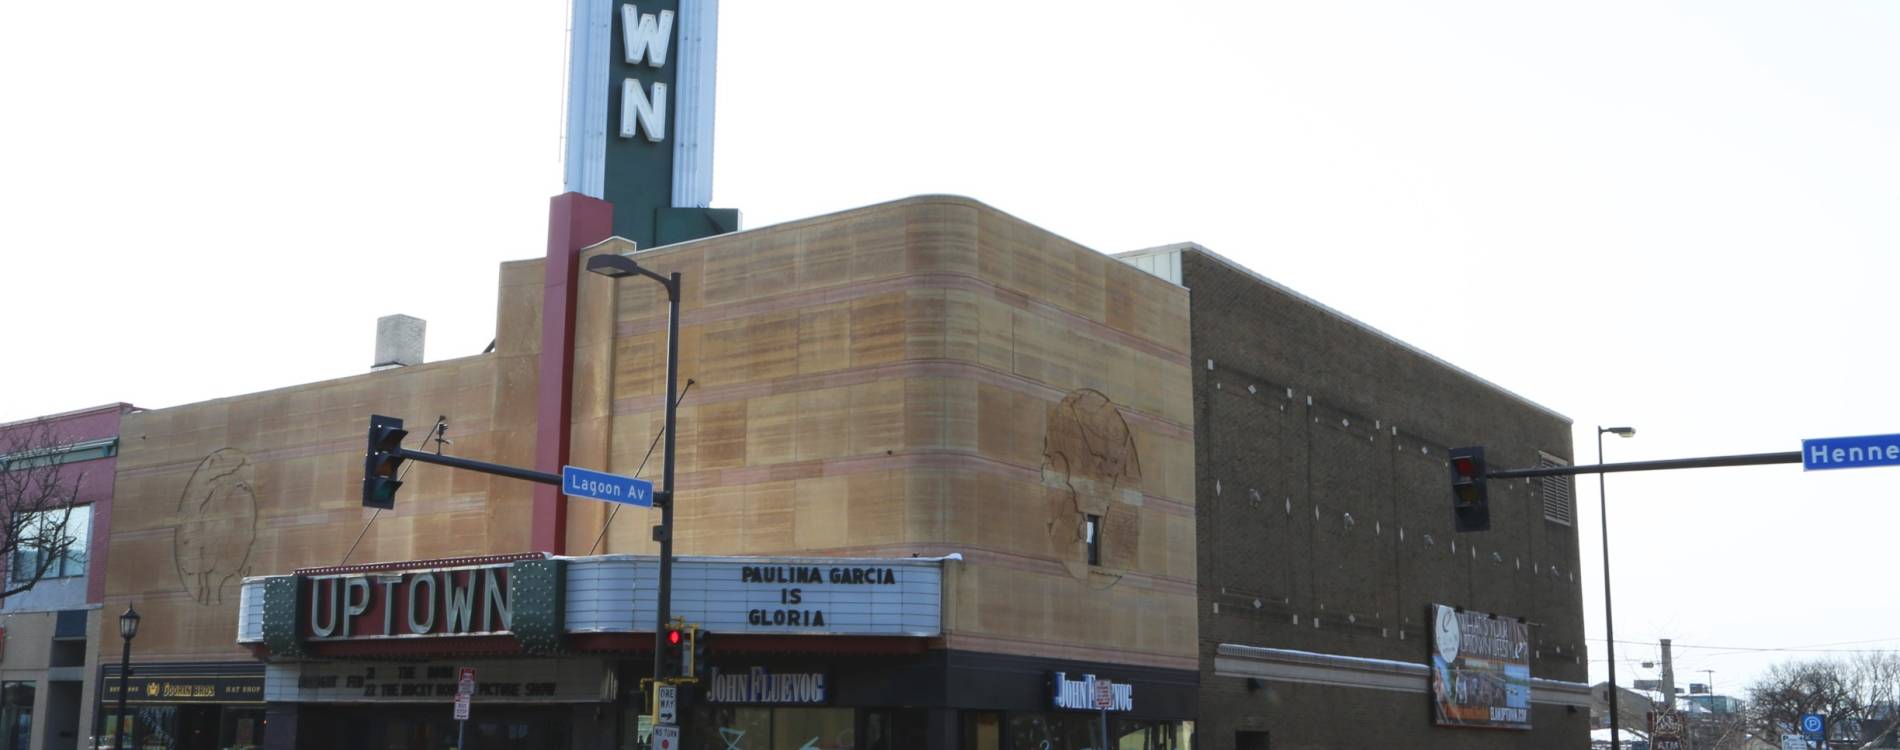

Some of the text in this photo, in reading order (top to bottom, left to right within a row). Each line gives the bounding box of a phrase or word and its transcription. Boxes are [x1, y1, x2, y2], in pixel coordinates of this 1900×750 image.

[572, 474, 645, 500] Lagoon Av
[741, 566, 896, 585] PAULINA GARCIA
[311, 569, 513, 638] UPTOWN
[781, 588, 802, 605] IS
[749, 609, 825, 627] GLORIA
[381, 684, 399, 697] THE
[660, 688, 674, 698] ONE
[706, 666, 825, 702] JOHN FLUEVOG
[1055, 672, 1085, 709] JOHN
